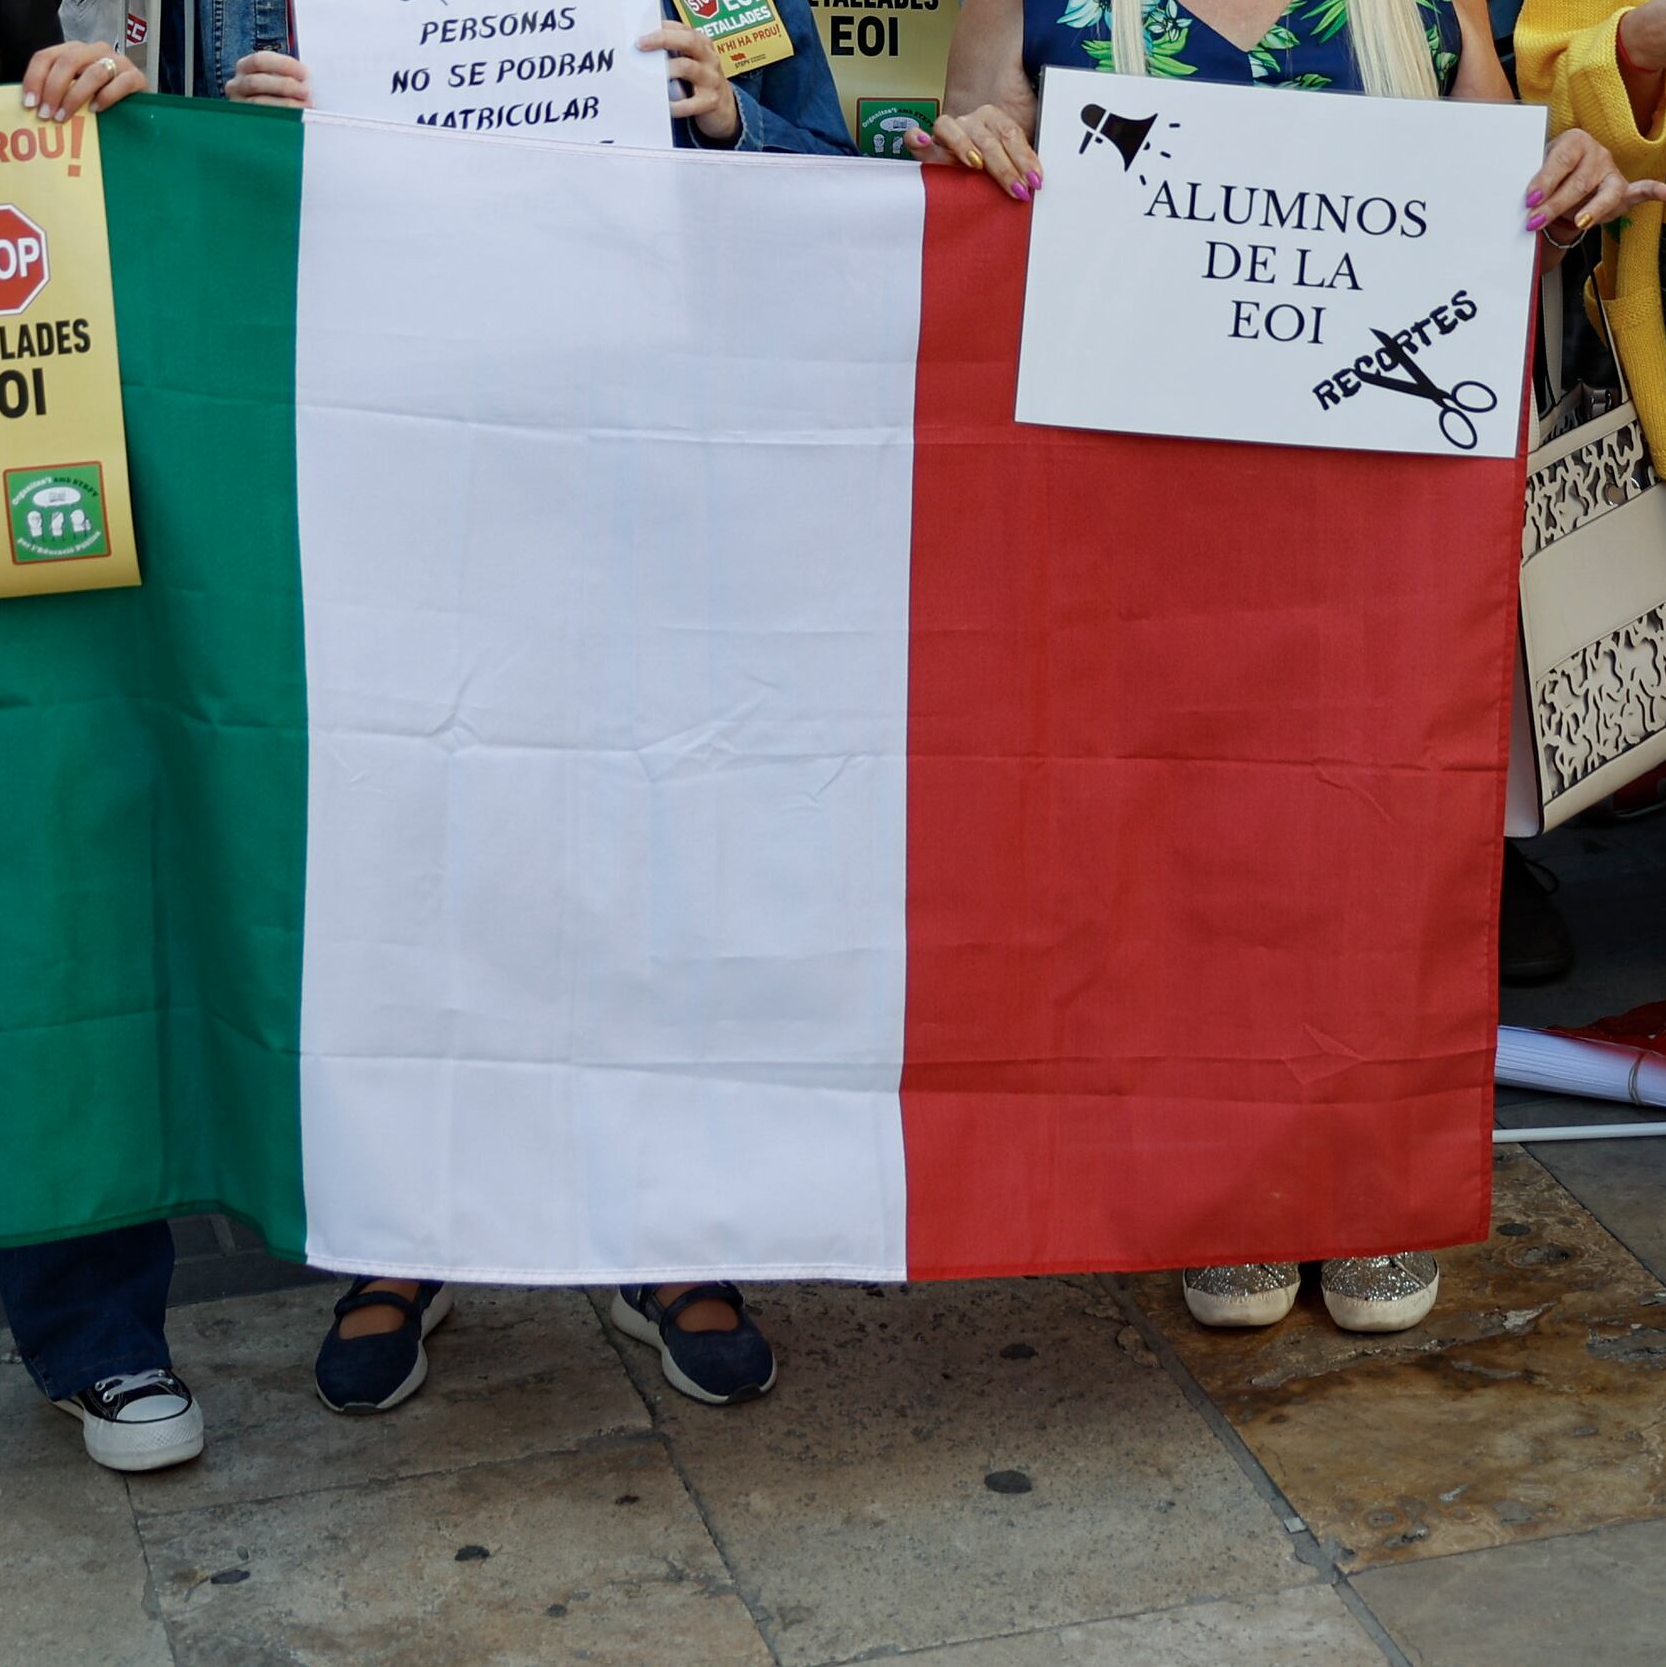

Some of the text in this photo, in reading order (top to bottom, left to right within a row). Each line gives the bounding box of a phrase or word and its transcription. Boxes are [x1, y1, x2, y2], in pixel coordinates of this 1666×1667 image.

[419, 6, 578, 46] PERSONAS
[753, 24, 782, 43] PROU!
[830, 15, 899, 57] EOI
[390, 48, 615, 95] NO SE PODRAN
[416, 95, 600, 131] MATRICULAR
[1143, 179, 1428, 238] ALUMNOS
[1201, 240, 1364, 291] DE LA
[1228, 300, 1327, 345] EOI
[1312, 289, 1479, 411] RECORTES
